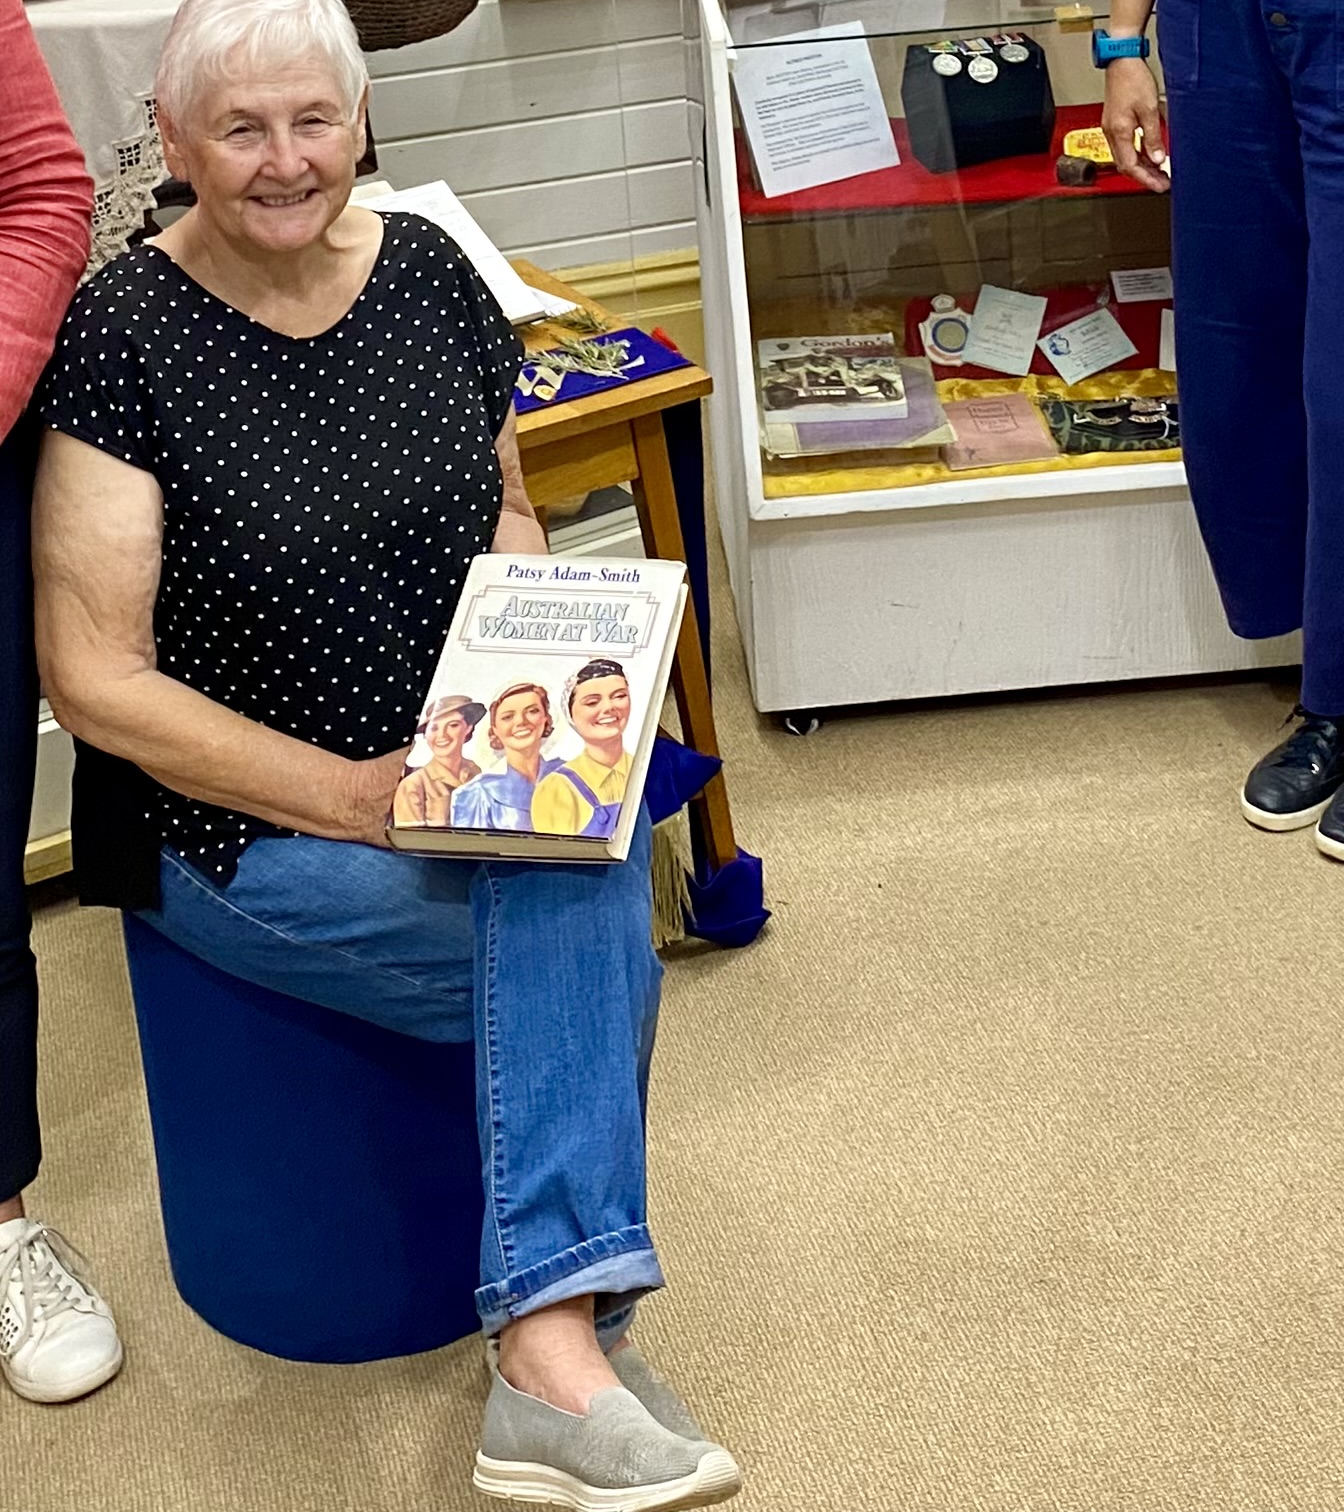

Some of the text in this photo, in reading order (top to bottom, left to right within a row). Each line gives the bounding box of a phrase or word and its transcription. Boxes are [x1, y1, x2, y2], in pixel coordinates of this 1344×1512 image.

[506, 564, 641, 583] Patsy Adam-Smith
[500, 595, 630, 622] AUSTRALIAN
[478, 615, 639, 644] WOMEN AT WAR
